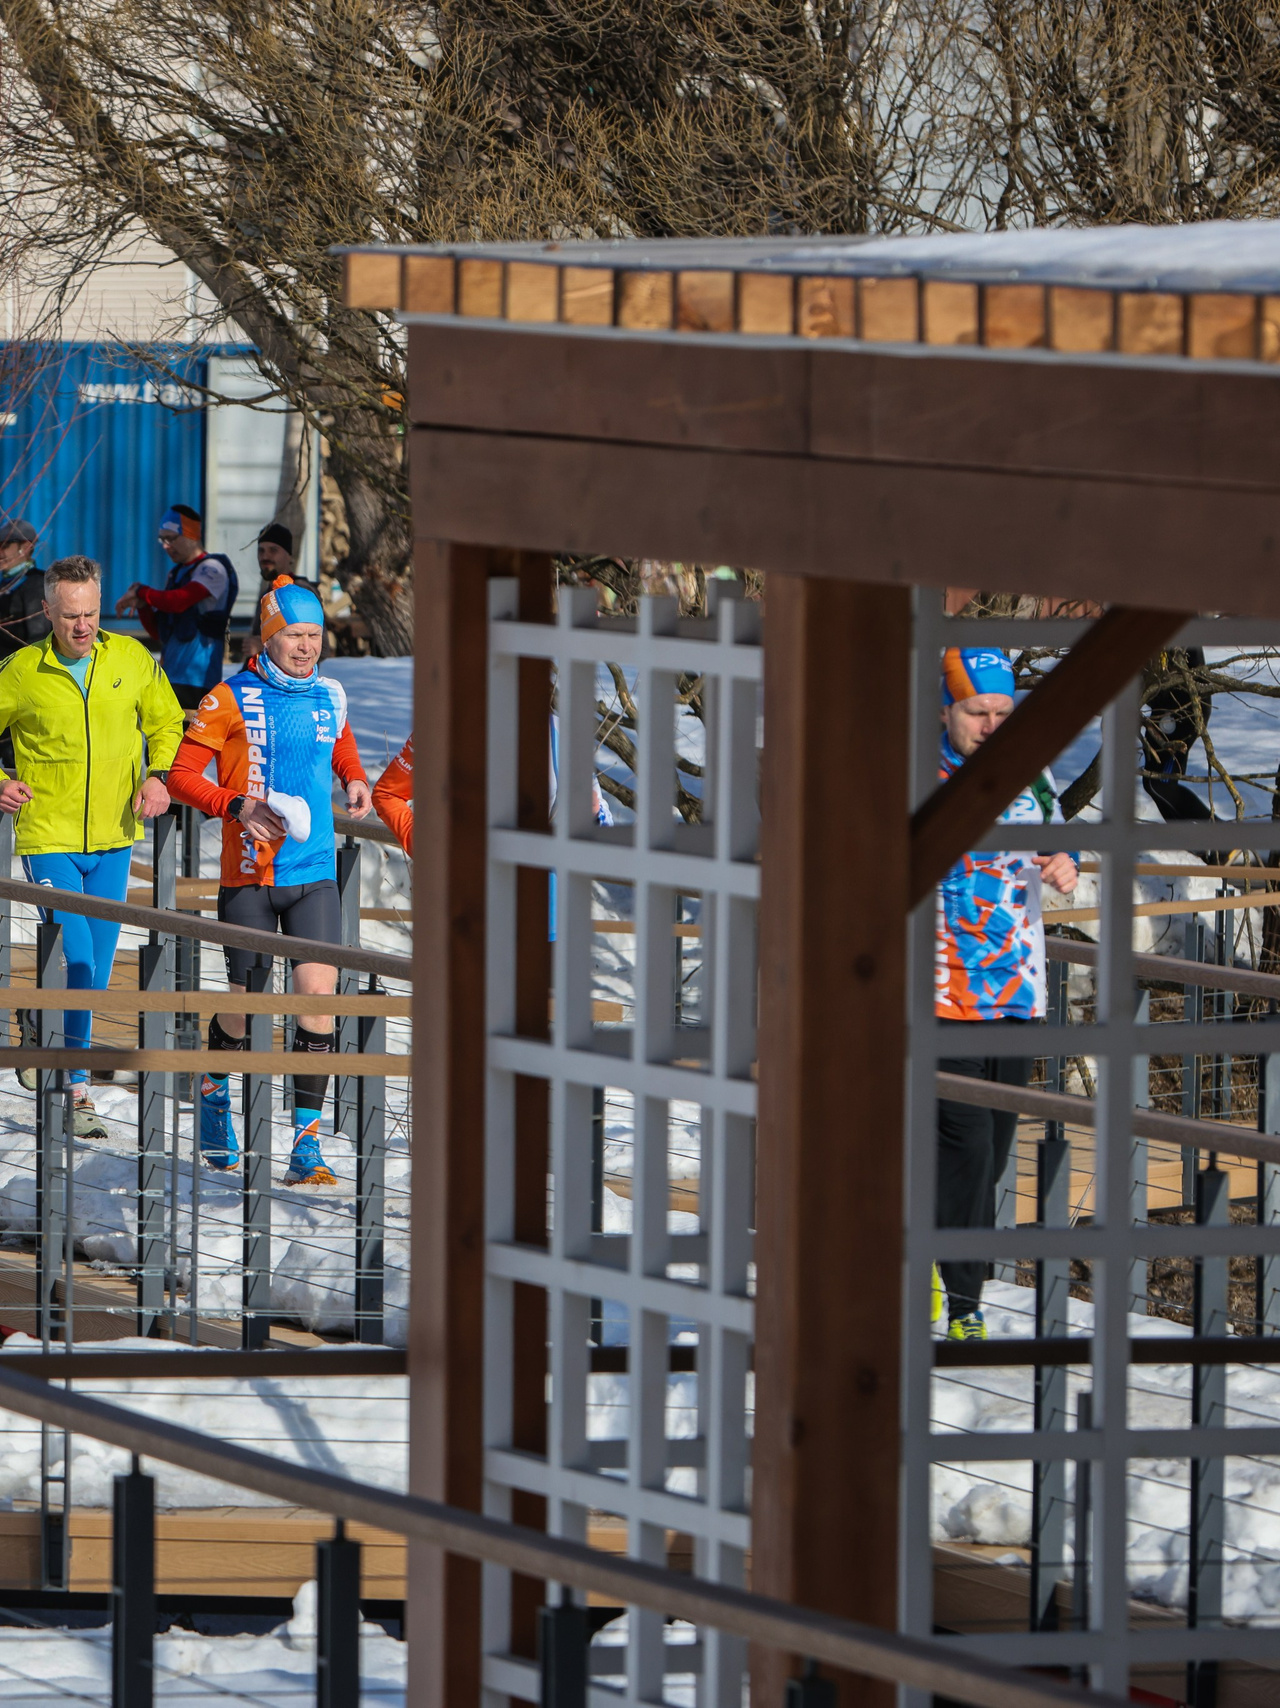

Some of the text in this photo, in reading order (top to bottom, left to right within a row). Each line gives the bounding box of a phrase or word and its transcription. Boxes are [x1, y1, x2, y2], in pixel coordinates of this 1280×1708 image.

[268, 715, 276, 730] club
[316, 724, 330, 734] Igor
[268, 730, 277, 756] running
